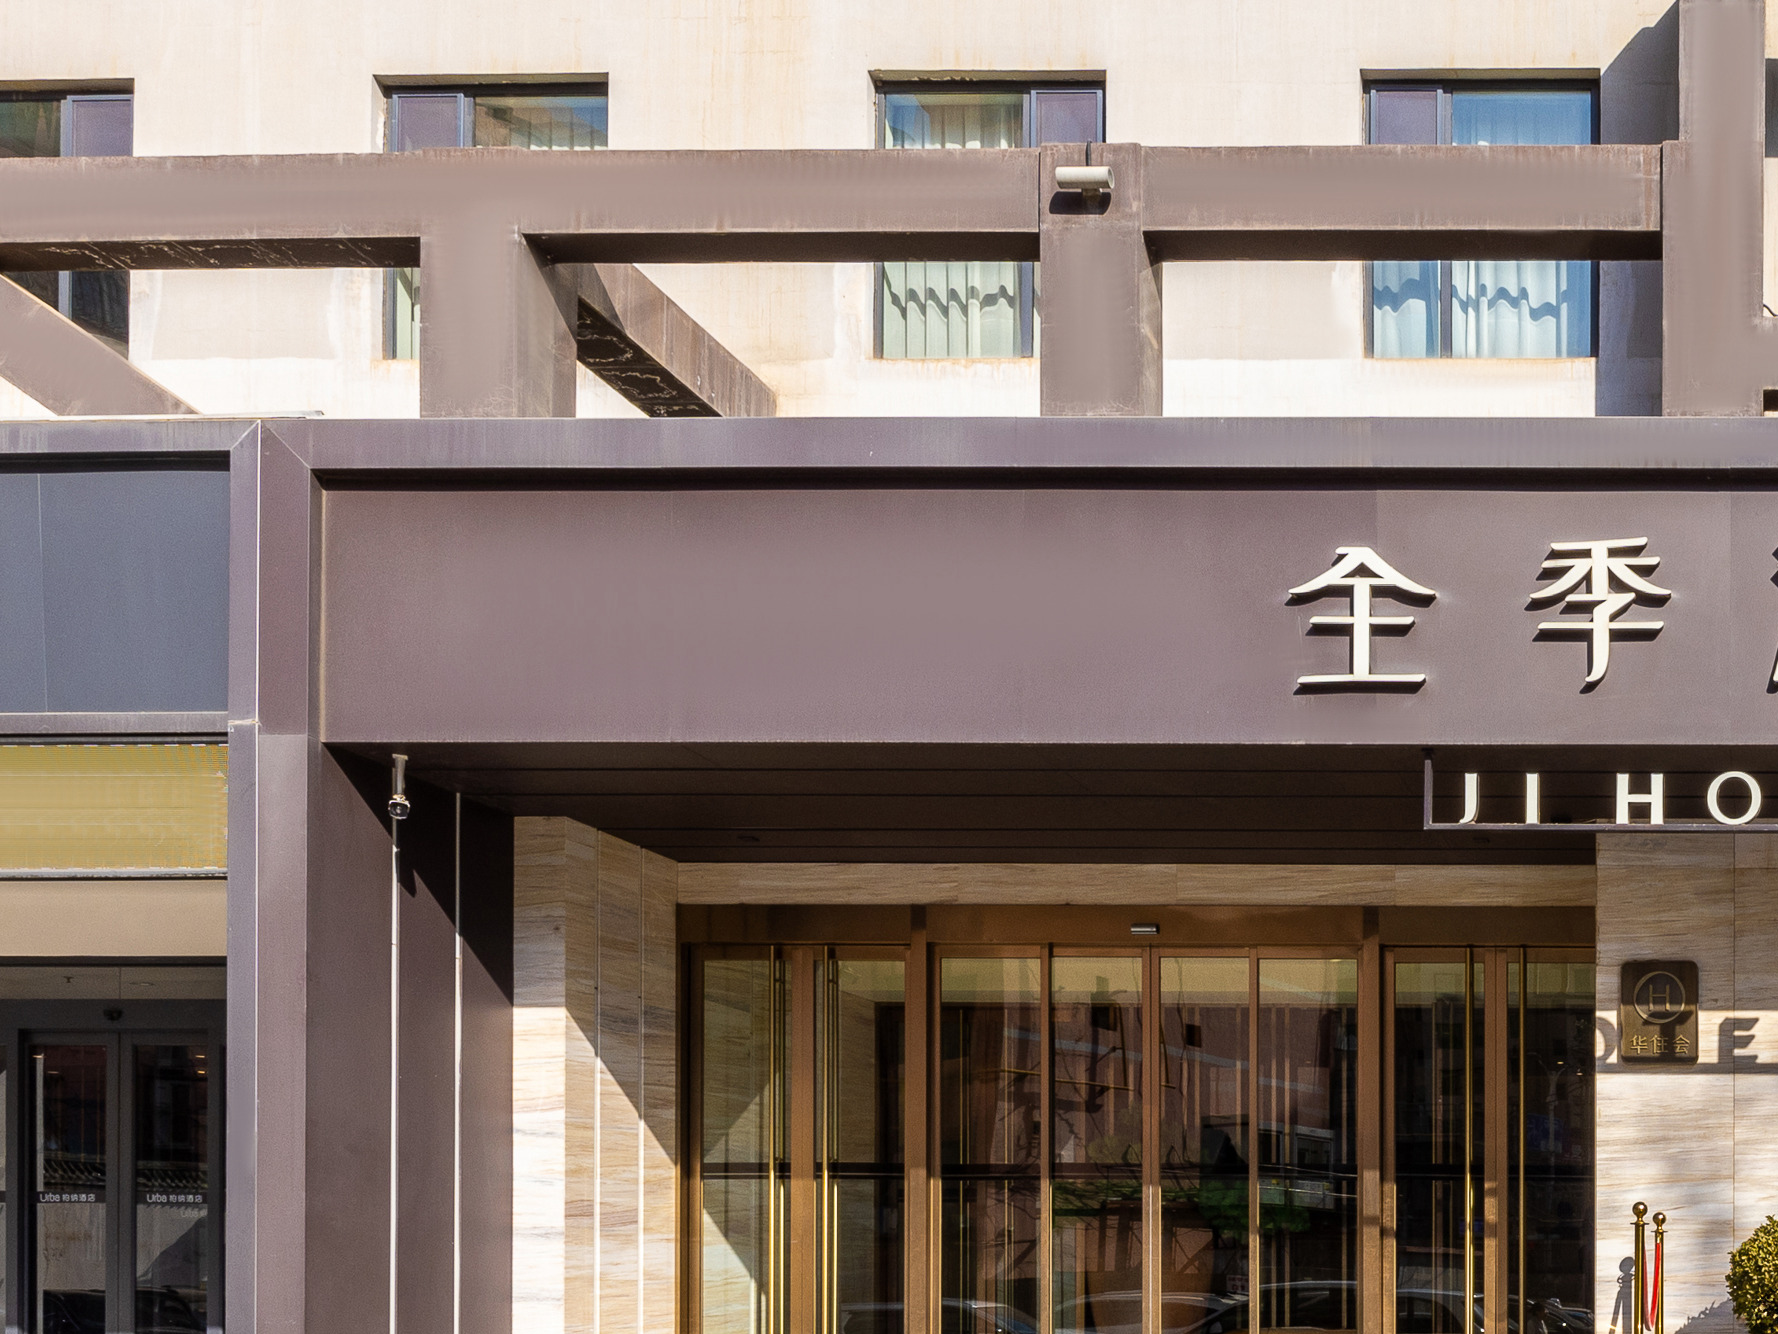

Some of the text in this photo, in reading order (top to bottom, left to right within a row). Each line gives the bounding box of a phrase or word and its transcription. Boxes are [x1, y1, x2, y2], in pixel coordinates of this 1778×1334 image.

[1458, 772, 1541, 825] JI
[1630, 1034, 1691, 1056] 华住会
